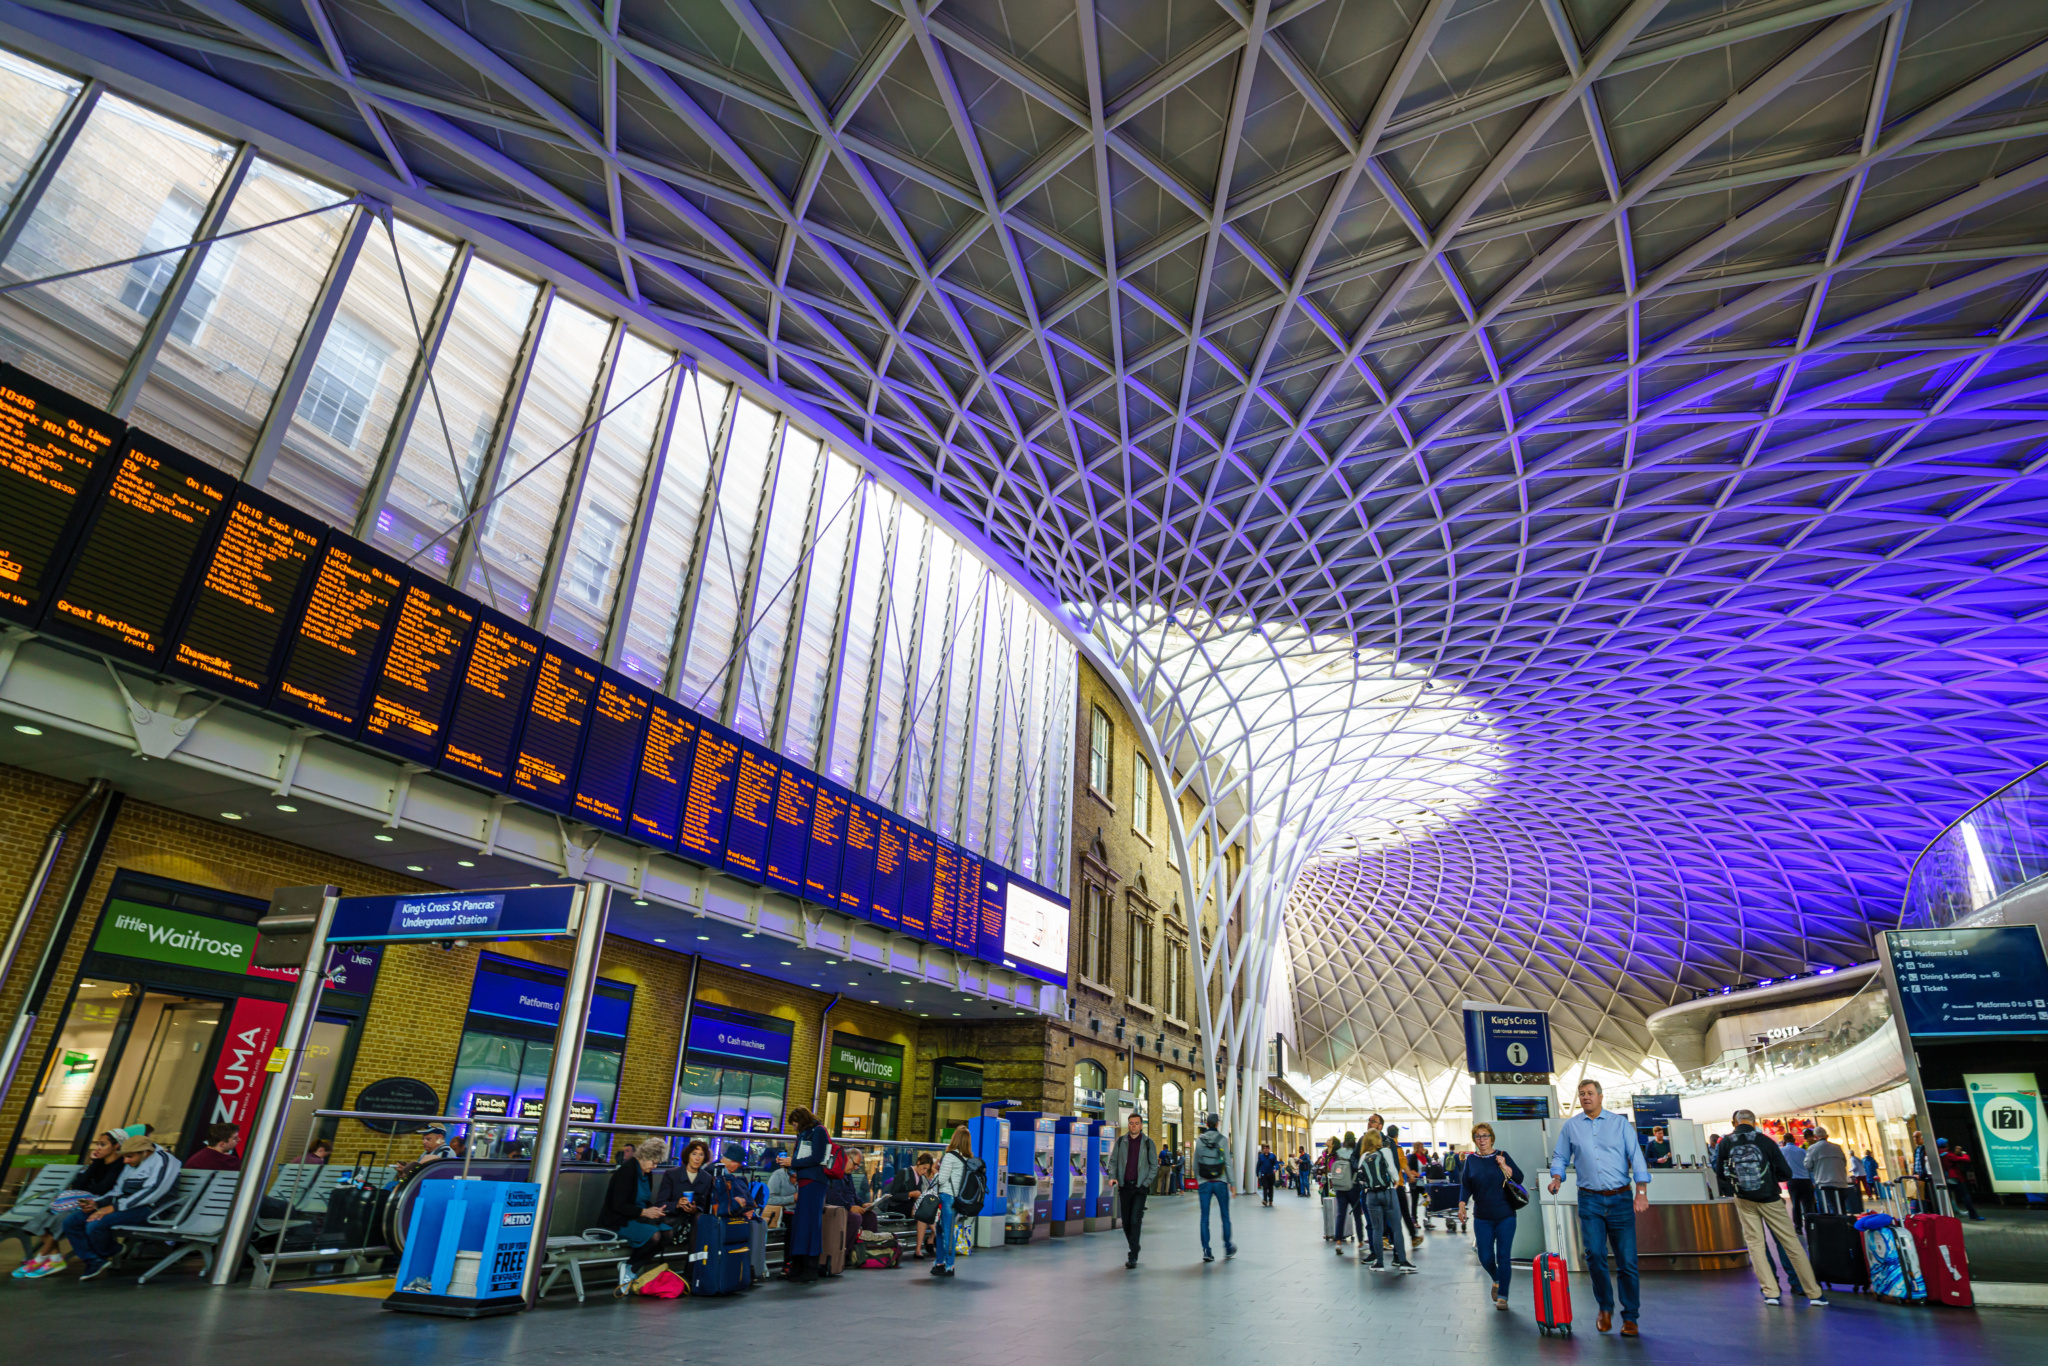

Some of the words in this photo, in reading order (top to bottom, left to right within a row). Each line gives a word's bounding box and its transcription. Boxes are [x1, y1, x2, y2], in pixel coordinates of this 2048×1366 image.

[0, 386, 36, 410] 10:06
[67, 419, 84, 433] On
[87, 428, 111, 446] time
[0, 398, 40, 426] ewark
[42, 420, 66, 438] Nth
[69, 432, 98, 452] Gate
[47, 442, 67, 457] Page
[122, 458, 141, 472] Ely
[129, 449, 160, 470] 10:12
[185, 477, 200, 490] On
[202, 484, 223, 501] time
[119, 468, 143, 484] Calling
[144, 481, 155, 489] at:
[172, 493, 189, 505] Page
[231, 510, 294, 546] Peterborough
[236, 501, 262, 520] 10:16
[268, 516, 289, 533] Expt
[293, 529, 317, 546] 10:18
[228, 519, 249, 534] Calling
[273, 541, 288, 552] Page
[322, 564, 346, 580] Boarding
[324, 555, 371, 584] Letchworth
[330, 546, 352, 563] 10:21
[371, 568, 382, 579] On
[384, 573, 400, 587] time
[405, 594, 441, 617] Edinburgh
[409, 586, 430, 601] 10:30
[446, 604, 457, 614] On
[458, 609, 472, 622] time
[57, 600, 93, 620] Great
[96, 613, 150, 640] Northern
[478, 629, 510, 650] Cambridge
[481, 621, 499, 635] 10:31
[502, 631, 518, 644] Expt
[520, 640, 537, 654] 10:34
[179, 643, 232, 670] Thameslink
[542, 660, 560, 674] Leeds
[545, 652, 562, 666] 10:33
[574, 667, 582, 676] On
[583, 671, 595, 682] time
[200, 662, 233, 680] Thameslink
[234, 676, 258, 689] service.
[282, 682, 327, 706] Thameslink
[605, 690, 631, 708] Cambridge
[628, 694, 636, 702] On
[636, 697, 647, 707] time
[369, 714, 389, 728] LNER
[651, 713, 684, 733] Peterborough
[448, 744, 483, 763] Thameslink
[515, 769, 531, 781] LNER
[576, 793, 593, 804] Great
[594, 799, 619, 814] Northern
[632, 813, 658, 828] Thameslink
[402, 902, 426, 914] King's
[427, 902, 450, 912] Cross
[452, 901, 461, 910] St
[462, 900, 495, 910] Pancras
[402, 916, 455, 928] Underground
[457, 914, 488, 925] Station
[114, 914, 148, 933] little
[148, 924, 243, 958] Waitrose
[1912, 939, 1956, 947] Underground
[351, 955, 373, 966] LNER
[282, 967, 300, 976] CLA
[520, 996, 553, 1009] Platforms
[554, 1002, 560, 1011] 0
[1491, 1016, 1514, 1026] King's
[727, 1035, 740, 1046] Cash
[741, 1038, 765, 1050] machines
[1767, 1026, 1801, 1039] COSTA
[840, 1050, 854, 1063] little
[854, 1056, 893, 1077] Waitrose
[210, 1027, 261, 1126] ZUMA
[476, 1098, 490, 1106] Free
[491, 1099, 506, 1108] Cash
[504, 1214, 531, 1225] METRO
[494, 1251, 525, 1273] FREE
